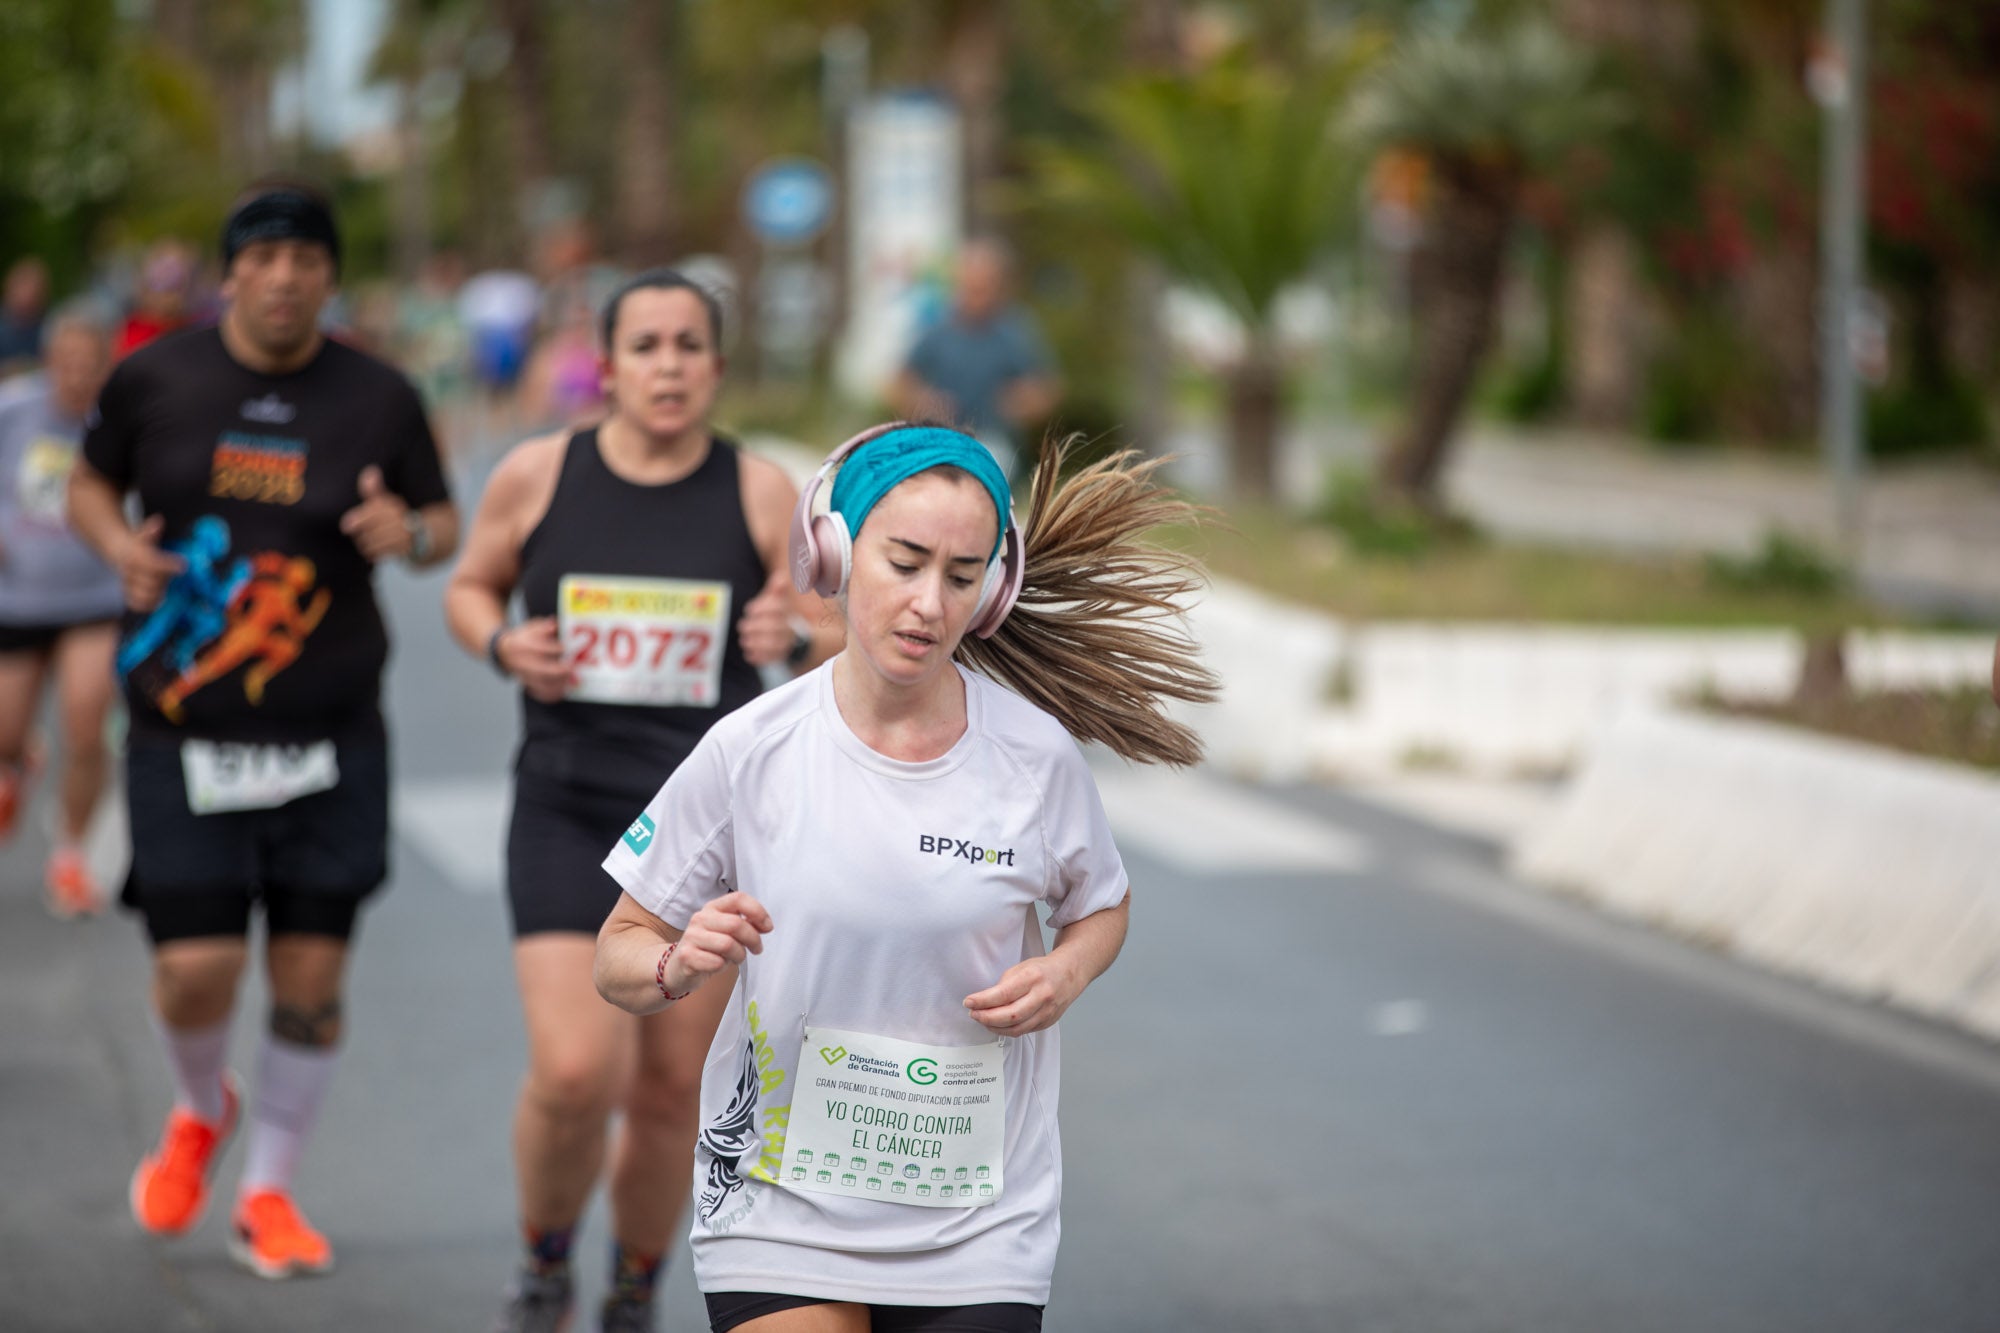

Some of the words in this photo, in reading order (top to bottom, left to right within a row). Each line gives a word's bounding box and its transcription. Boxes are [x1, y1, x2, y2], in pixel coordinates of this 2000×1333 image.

[571, 624, 711, 672] 2072
[920, 834, 1015, 867] BPXport
[847, 1062, 859, 1070] de
[861, 1065, 900, 1078] Granada
[849, 1053, 899, 1069] Diputación
[945, 1062, 983, 1070] asociación
[942, 1078, 967, 1086] contra
[969, 1077, 976, 1085] el
[977, 1075, 997, 1085] cáncer
[944, 1069, 978, 1078] española
[815, 1077, 836, 1089] GRAN
[838, 1081, 867, 1094] PREMIO
[868, 1086, 878, 1096] DE
[881, 1087, 906, 1100] FONDO
[908, 1091, 951, 1106] DIPUTACIÓN
[953, 1096, 962, 1106] DE
[963, 1094, 990, 1104] GRANADA
[826, 1100, 847, 1121] YO
[852, 1104, 908, 1131] CORRO
[913, 1114, 972, 1135] CONTRA
[852, 1129, 870, 1150] EL
[876, 1132, 943, 1159] CÁNCER
